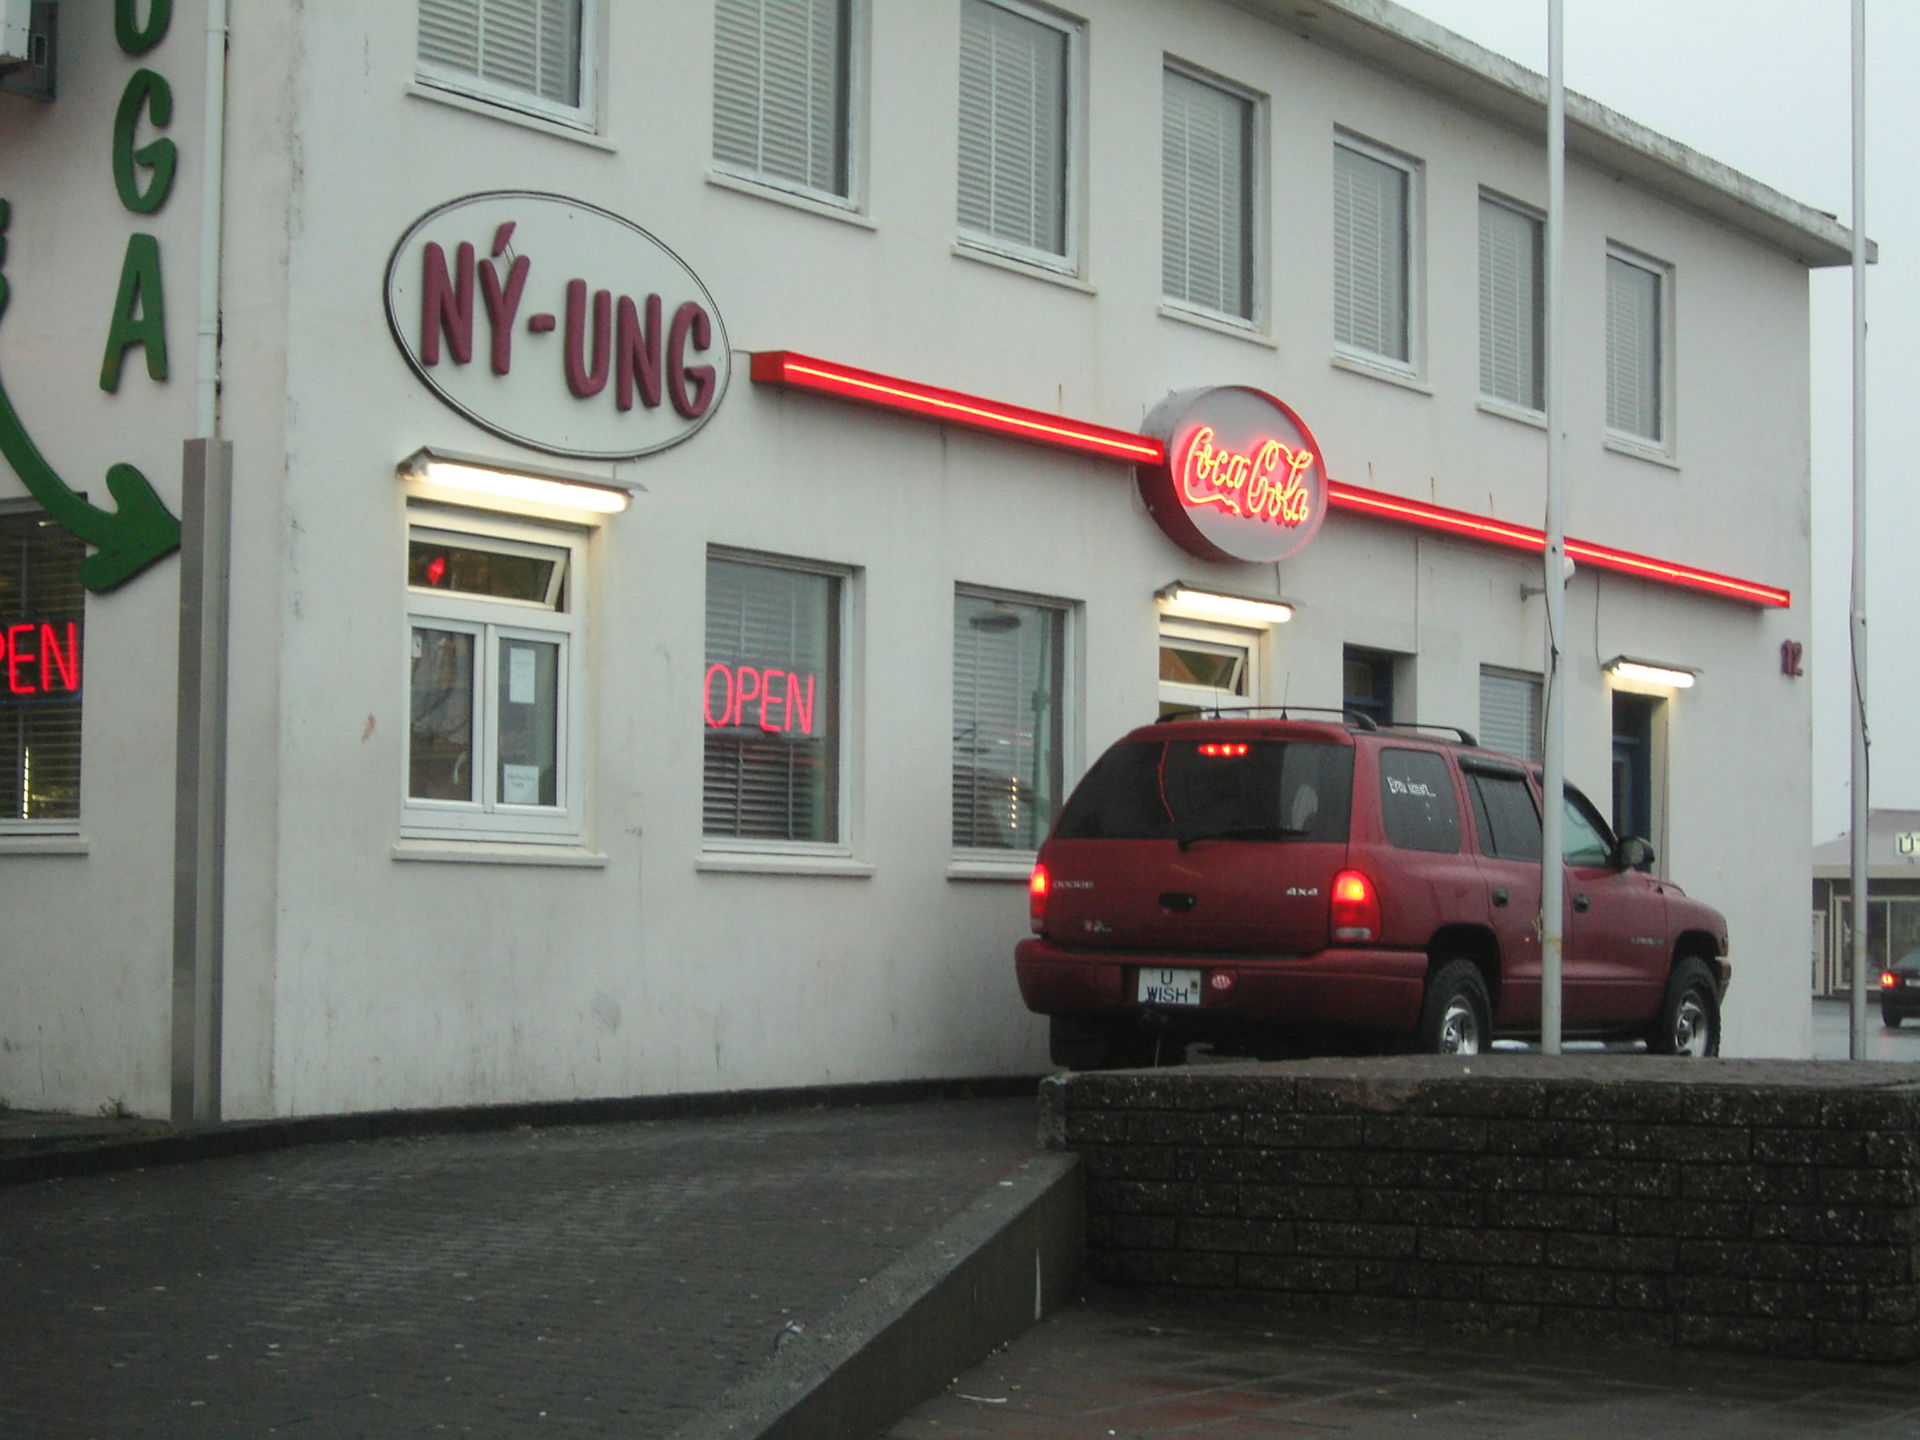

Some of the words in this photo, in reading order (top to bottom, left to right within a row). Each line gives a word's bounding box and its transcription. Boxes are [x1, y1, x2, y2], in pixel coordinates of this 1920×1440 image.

[420, 221, 717, 419] NÝ-UNG
[0, 622, 79, 694] EN
[704, 664, 815, 734] OPEN
[1147, 986, 1188, 1003] WISH
[1161, 970, 1173, 985] U
